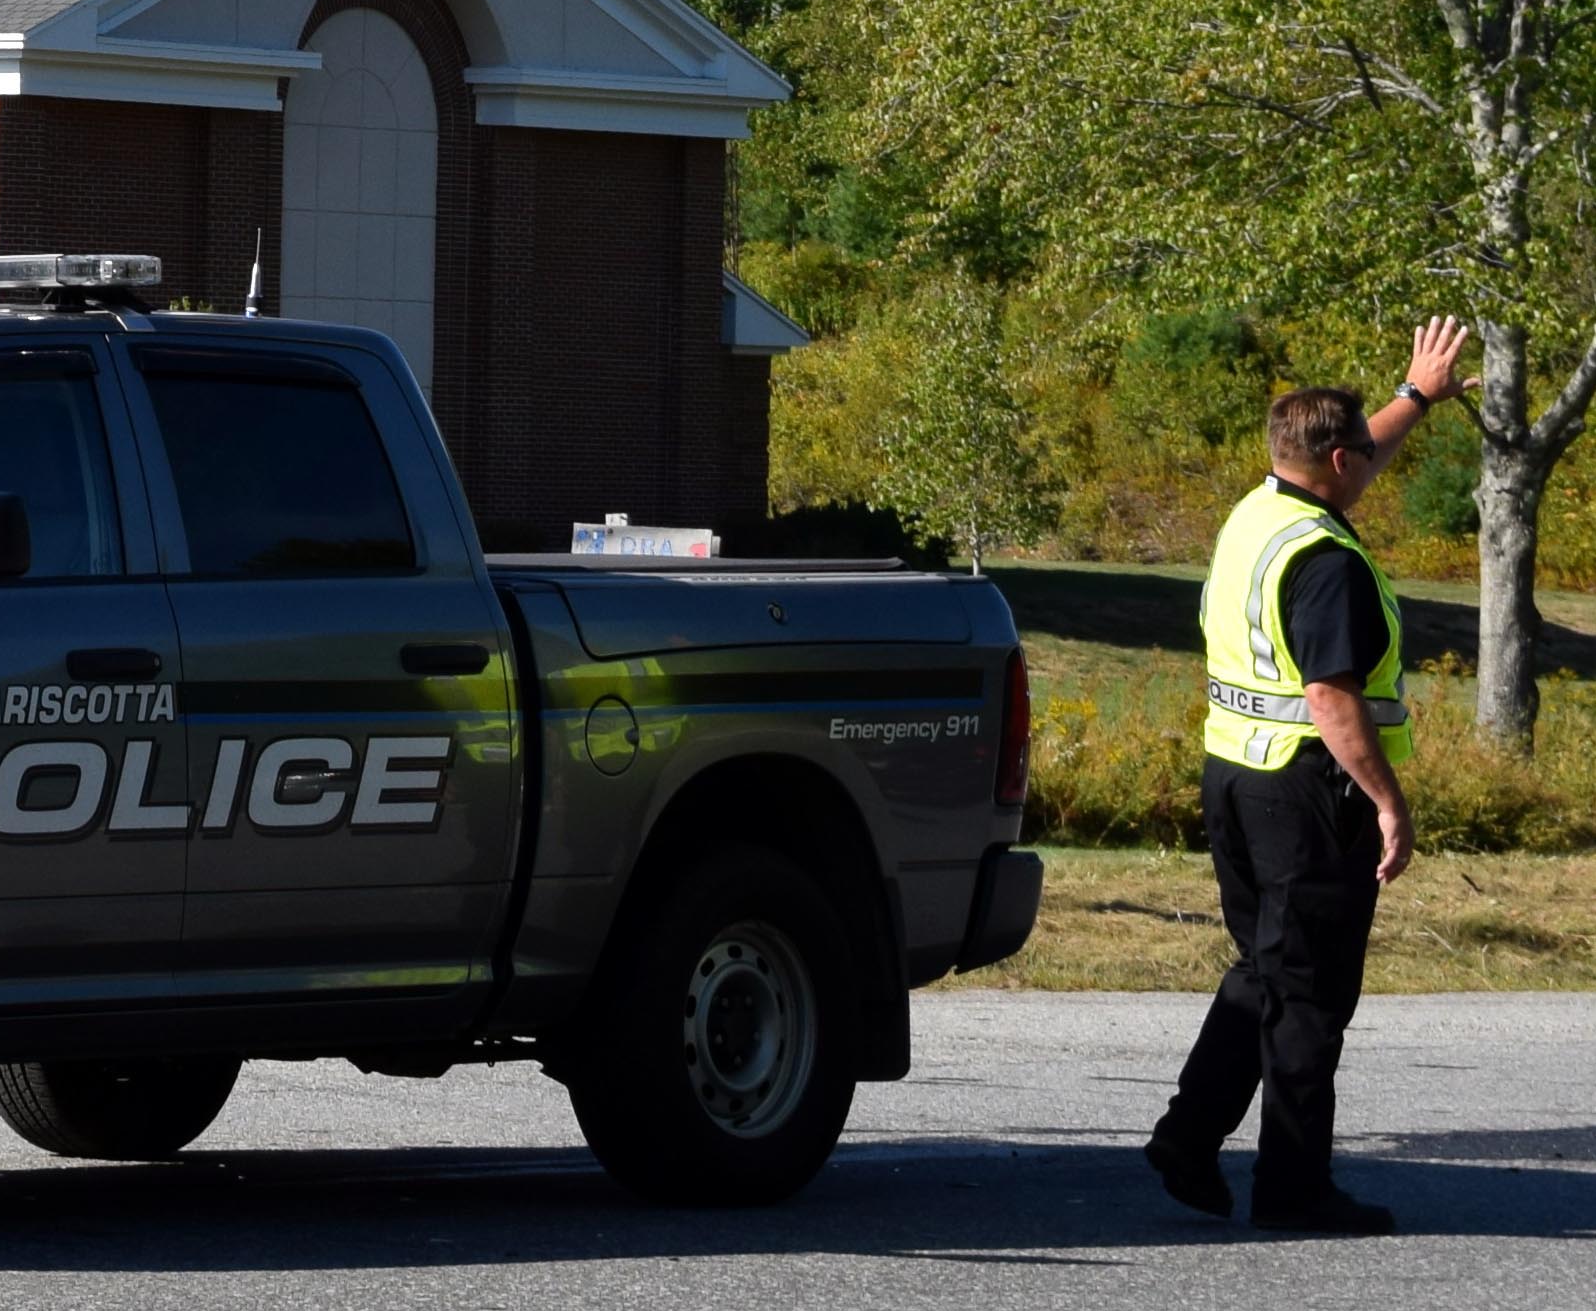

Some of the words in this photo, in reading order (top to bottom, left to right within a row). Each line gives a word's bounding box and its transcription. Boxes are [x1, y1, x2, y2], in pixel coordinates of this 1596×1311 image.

[1210, 680, 1266, 715] OLICE
[828, 717, 942, 745] Emergency
[945, 714, 980, 737] 911
